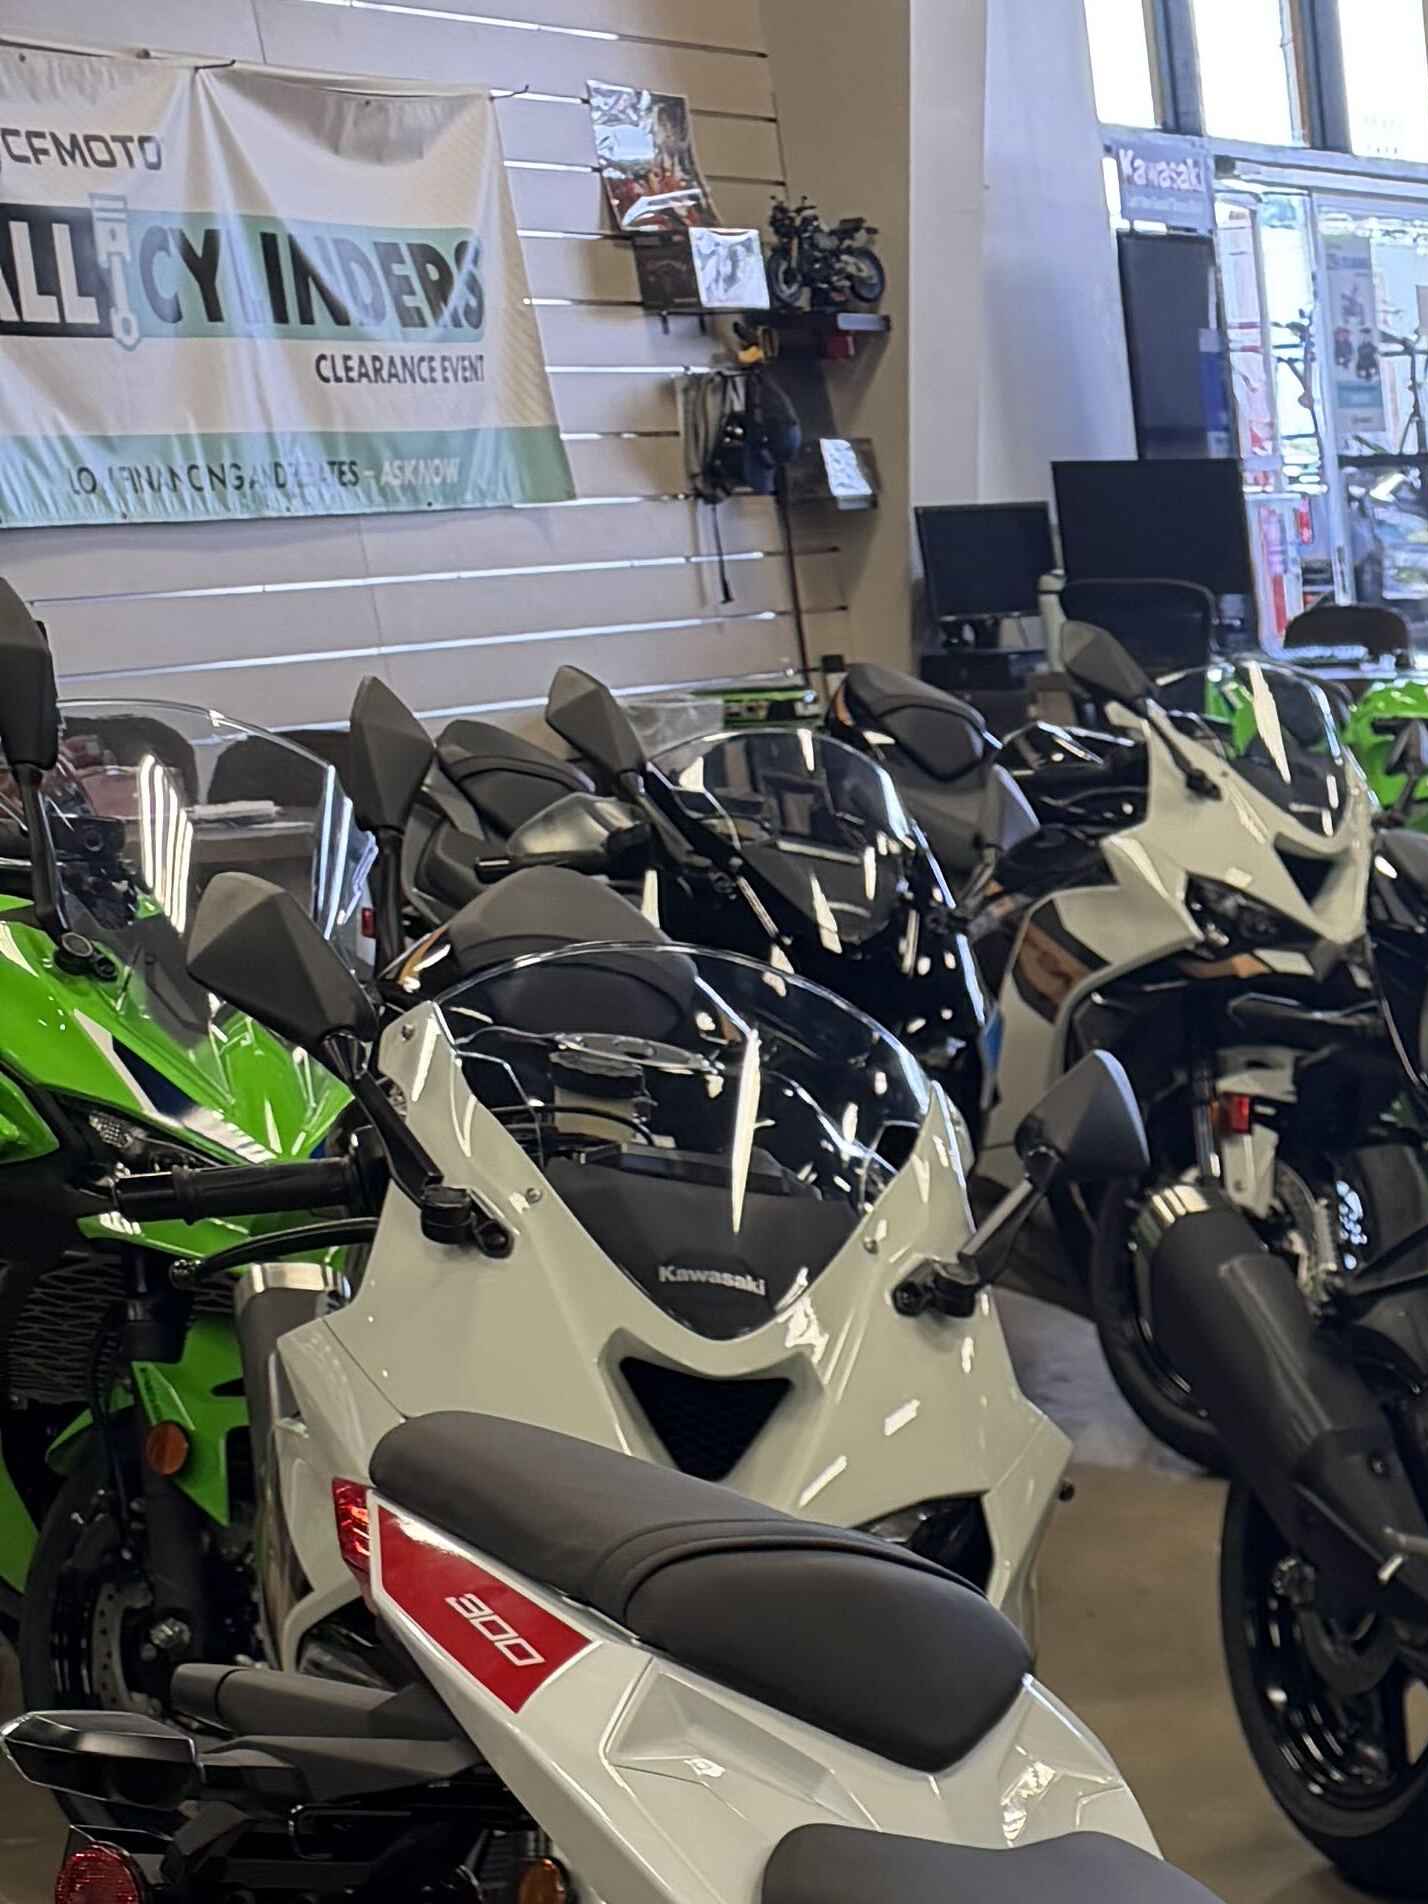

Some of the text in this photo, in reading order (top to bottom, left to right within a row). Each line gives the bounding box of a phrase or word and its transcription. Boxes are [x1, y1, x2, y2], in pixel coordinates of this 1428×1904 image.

[1, 127, 163, 171] CFMOTO
[315, 353, 485, 384] CLEARANCE EVENT
[658, 1264, 766, 1296] Kawasaki
[444, 1593, 546, 1667] 300
